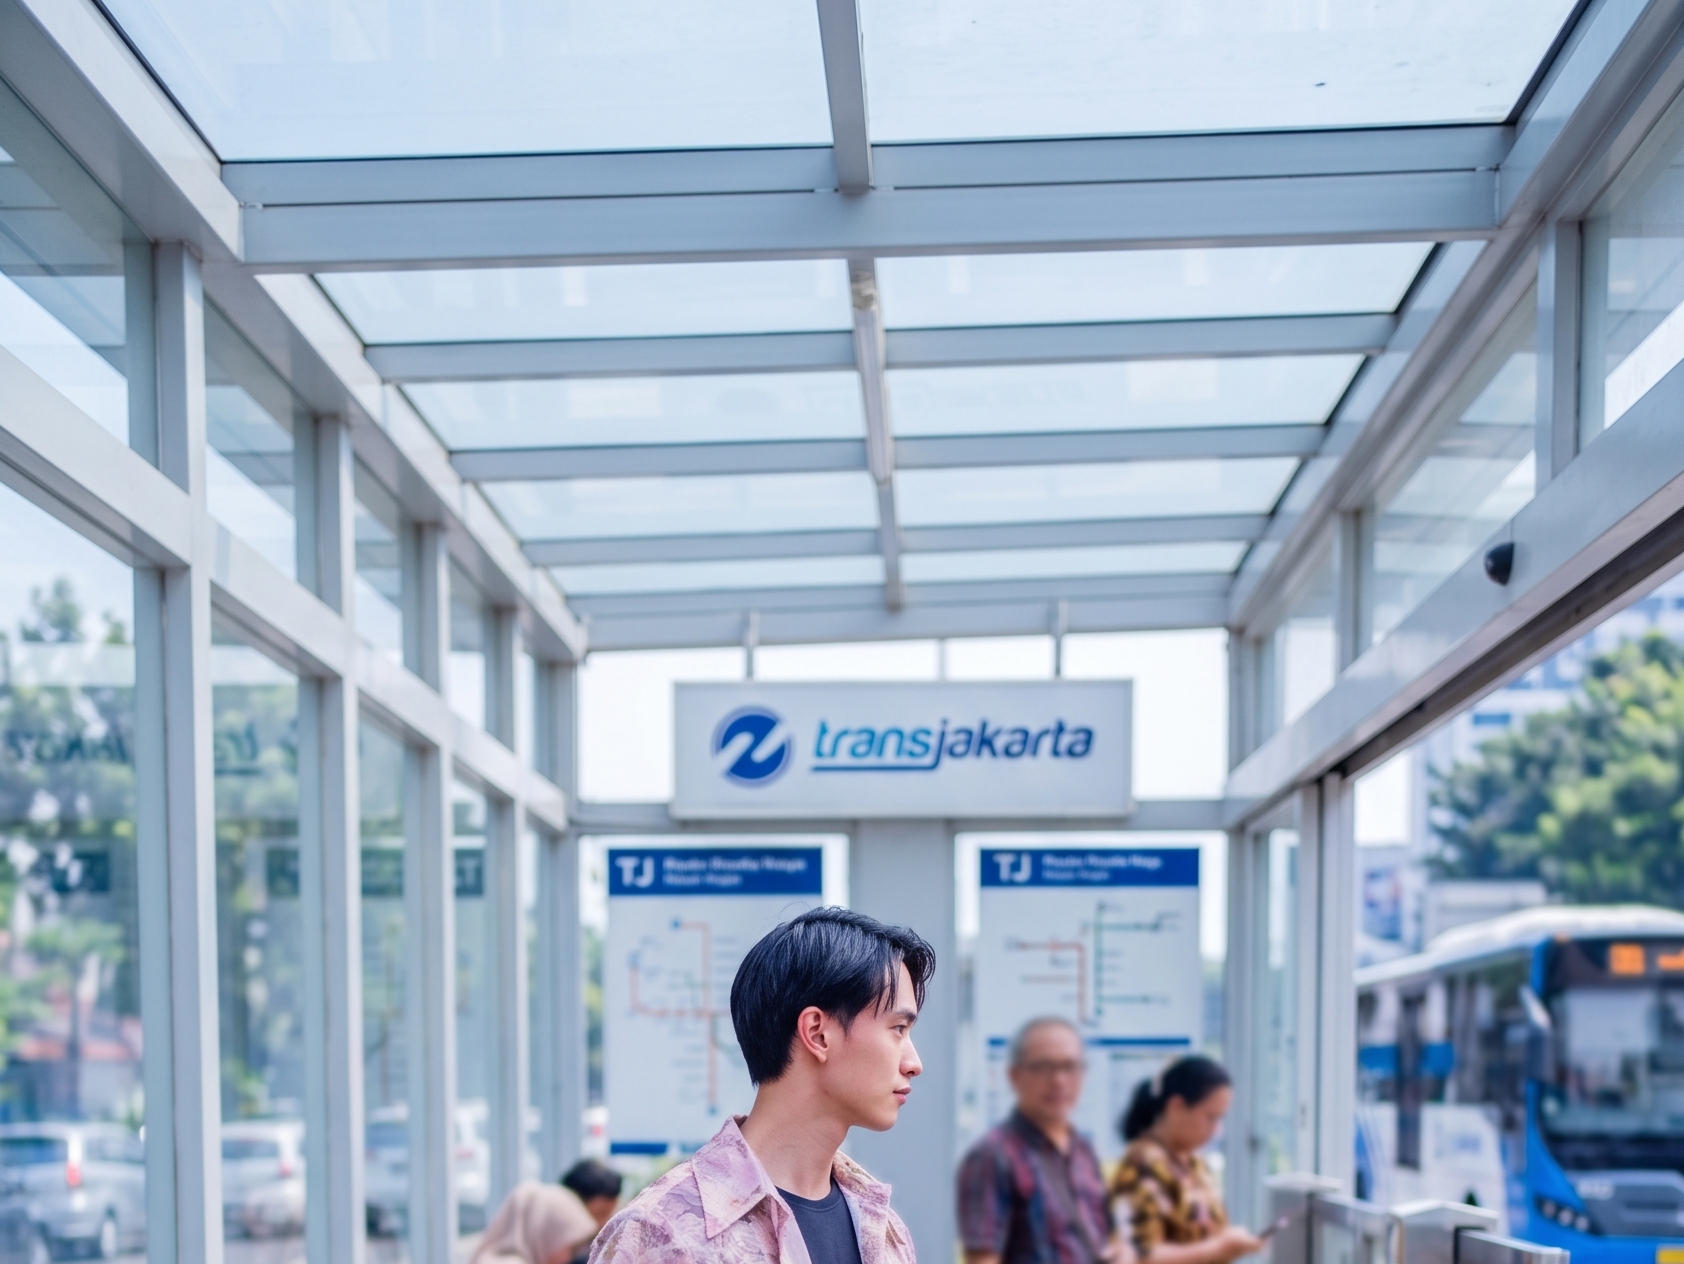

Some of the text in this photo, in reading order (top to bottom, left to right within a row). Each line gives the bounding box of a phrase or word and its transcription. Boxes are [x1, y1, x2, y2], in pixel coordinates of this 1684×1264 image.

[813, 719, 1095, 772] transjakarta
[616, 857, 655, 887] TJ
[993, 854, 1032, 882] TJ
